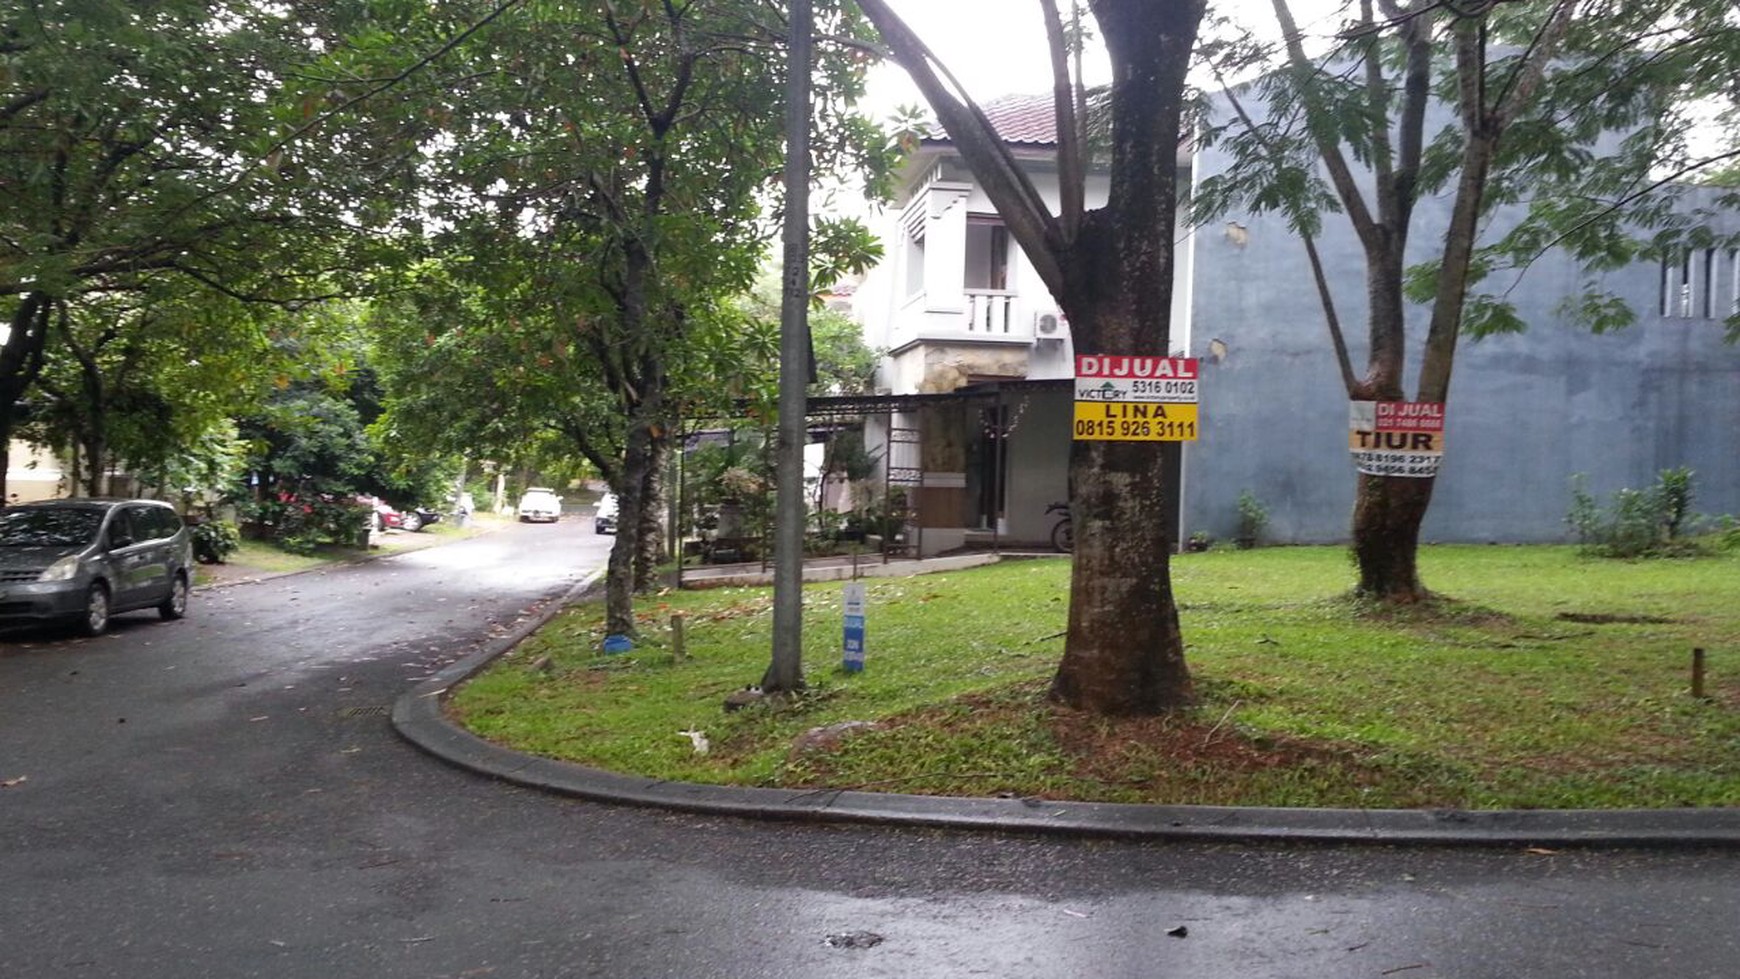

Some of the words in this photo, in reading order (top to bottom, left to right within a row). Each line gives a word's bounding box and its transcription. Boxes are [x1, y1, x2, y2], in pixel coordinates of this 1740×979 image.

[1081, 357, 1194, 377] DIJUAL
[1133, 381, 1161, 393] 5316
[1165, 382, 1195, 394] 0102
[1105, 404, 1167, 419] LINA
[1378, 403, 1396, 416] DI
[1398, 404, 1443, 417] JUAL
[1076, 420, 1115, 436] 0815
[1121, 420, 1150, 437] 926
[1157, 421, 1195, 437] 3111
[1356, 430, 1434, 450] TIUR
